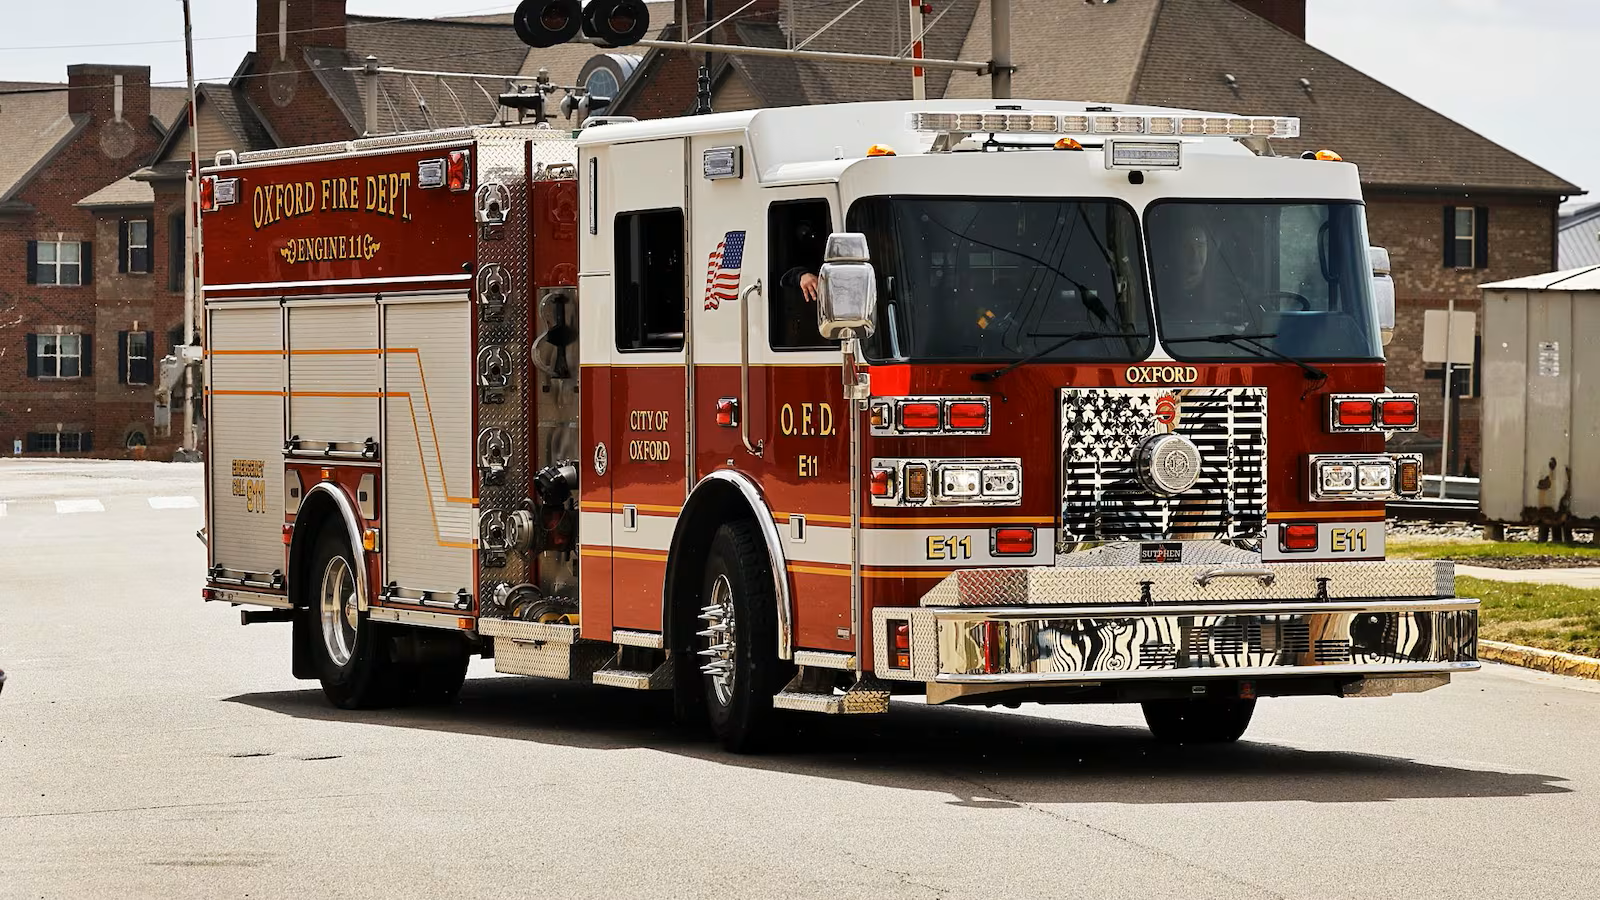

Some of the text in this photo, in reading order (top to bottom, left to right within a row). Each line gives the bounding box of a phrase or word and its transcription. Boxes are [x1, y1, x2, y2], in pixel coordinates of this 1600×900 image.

[253, 172, 412, 230] OXFORD FIRE DEPT.
[297, 235, 362, 261] ENGINE 11
[1125, 366, 1198, 383] OXFORD
[630, 410, 669, 431] CITY OF
[629, 440, 670, 461] OXFORD
[798, 455, 818, 477] E11
[247, 479, 265, 514] 911
[927, 535, 971, 560] E11
[1331, 528, 1366, 552] E11
[1142, 549, 1181, 558] SUTPHEN
